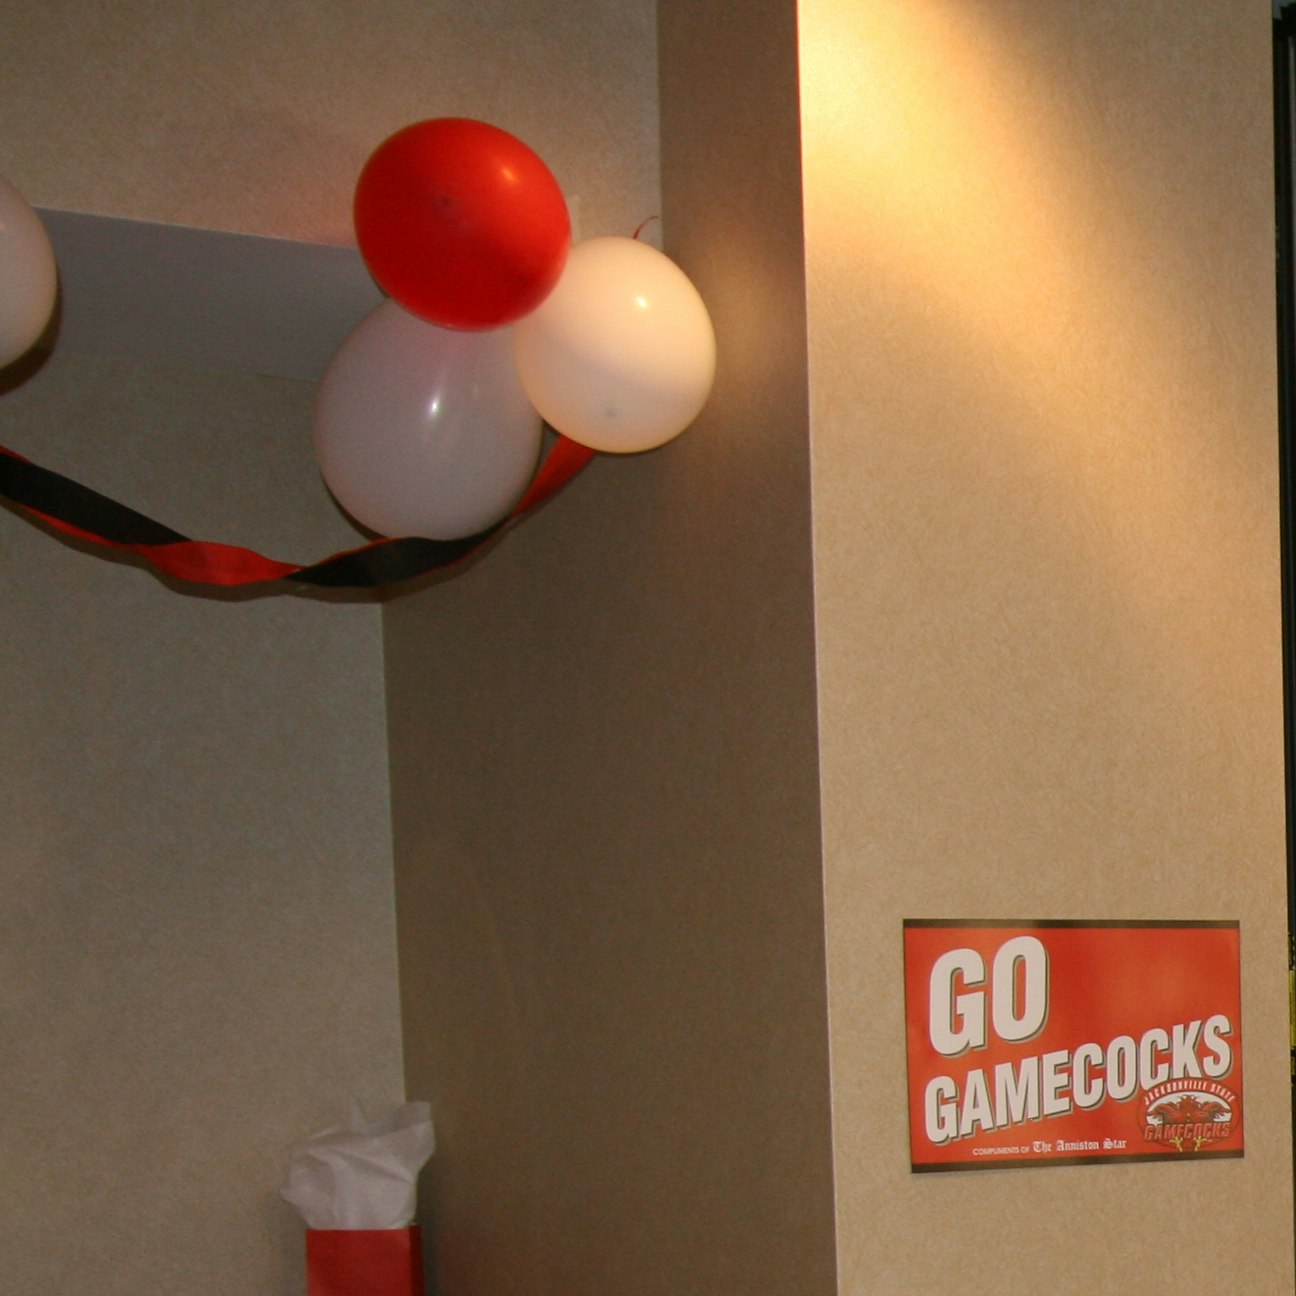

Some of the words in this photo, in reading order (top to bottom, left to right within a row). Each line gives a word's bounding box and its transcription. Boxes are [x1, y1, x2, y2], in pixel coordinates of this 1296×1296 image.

[929, 935, 1048, 1056] GO
[924, 1014, 1233, 1144] GAMECOCKS
[1144, 1080, 1208, 1105] JACKSONVILLE
[1210, 1083, 1235, 1103] STATE
[1144, 1122, 1232, 1140] GAMECOCKS
[1032, 1140, 1052, 1153] The
[1056, 1139, 1100, 1152] Anniston
[1103, 1137, 1127, 1150] Star
